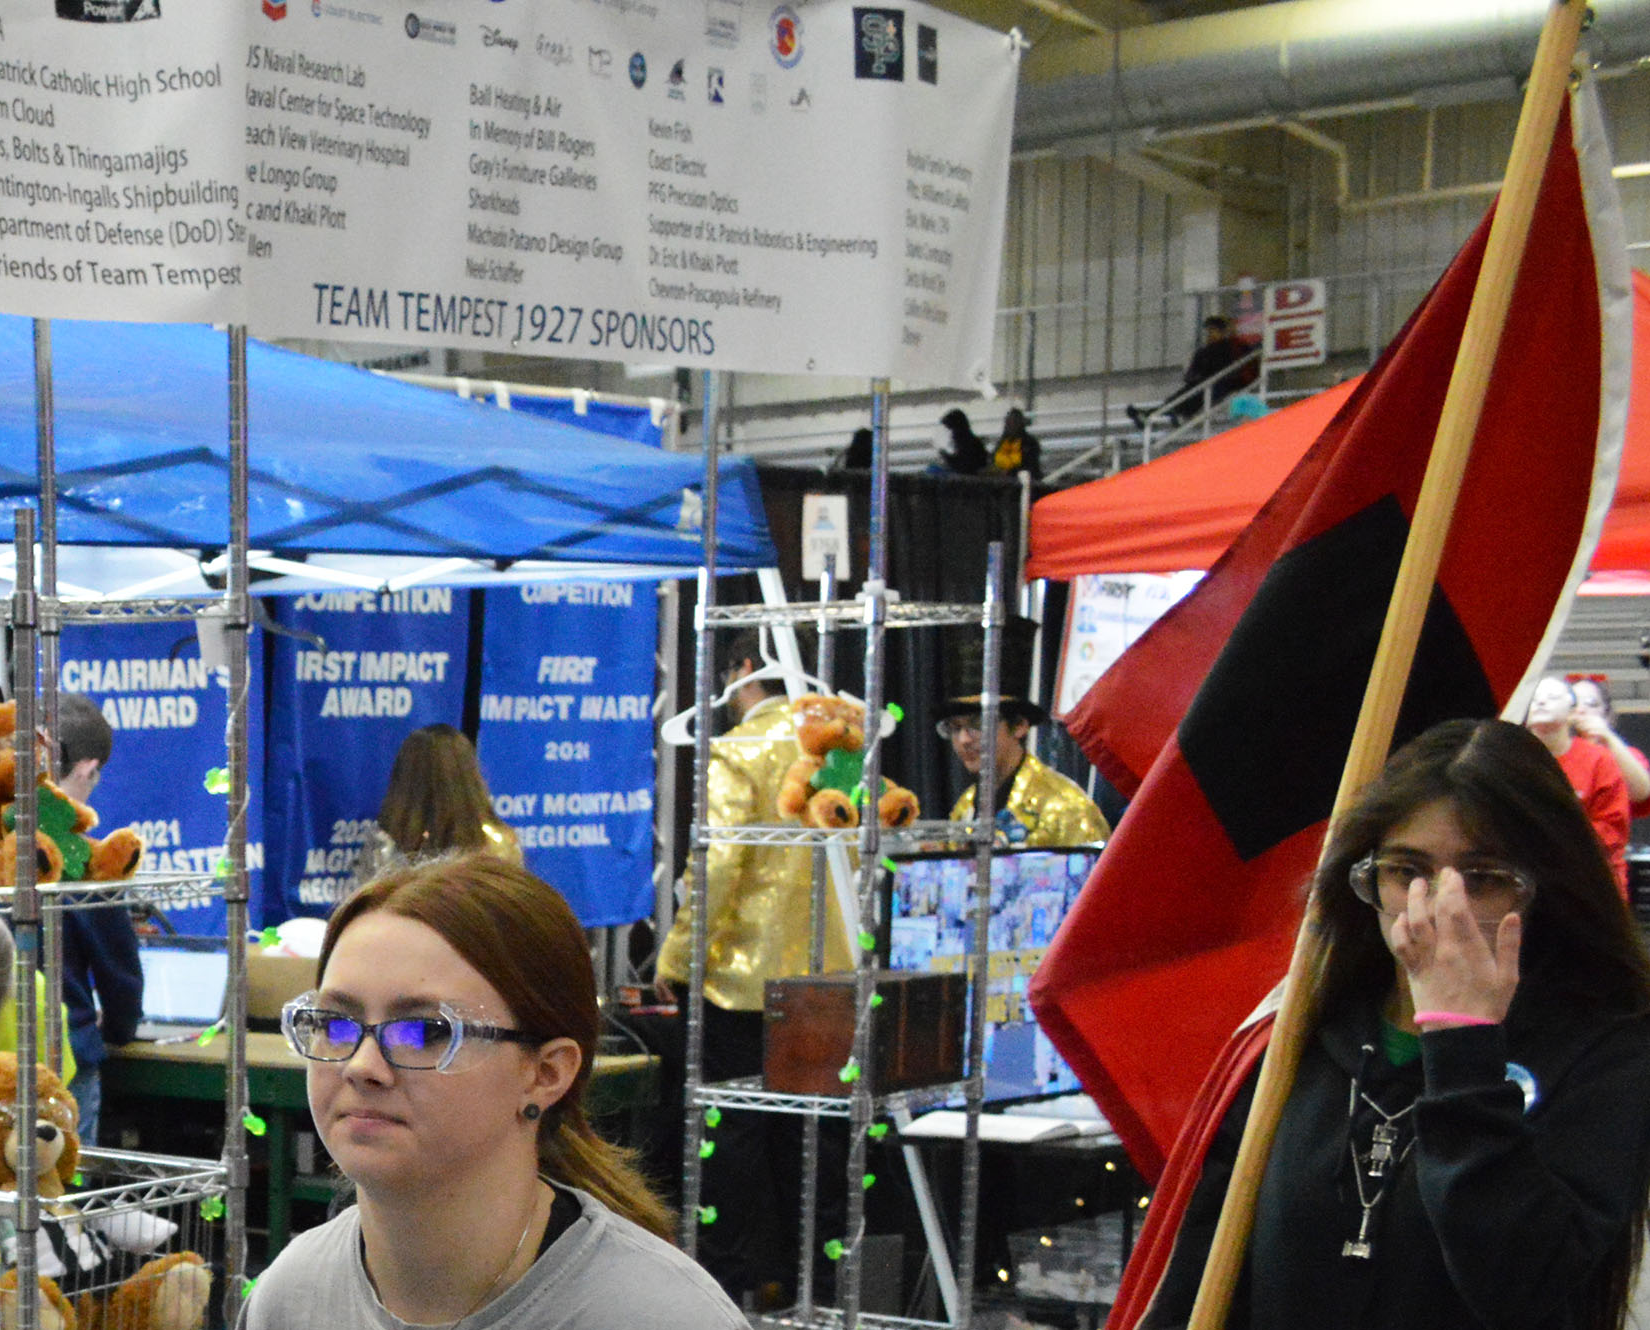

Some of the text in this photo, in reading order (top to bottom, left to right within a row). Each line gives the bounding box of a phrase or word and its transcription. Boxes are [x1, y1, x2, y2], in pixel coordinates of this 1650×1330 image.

[40, 65, 101, 98] Catholic
[105, 73, 151, 103] High
[156, 63, 222, 93] School
[263, 47, 296, 75] Naval
[299, 53, 344, 85] Research
[346, 62, 366, 89] Lab
[12, 98, 55, 128] Cloud
[279, 87, 315, 116] Center
[318, 93, 333, 118] for
[335, 97, 366, 127] Space
[368, 103, 432, 140] Technology
[533, 94, 541, 116] &
[544, 96, 562, 119] Air
[246, 124, 410, 168] each View Veterinary Hospital
[470, 118, 481, 140] In
[524, 127, 536, 148] of
[537, 129, 555, 151] Bill
[558, 131, 596, 161] Rogers
[13, 136, 50, 166] Bolts
[53, 150, 64, 167] &
[67, 144, 189, 178] Thingamajigs
[260, 160, 300, 192] Longo
[303, 166, 338, 196] Group
[502, 158, 546, 185] Furniture
[549, 165, 598, 191] Galleries
[123, 181, 239, 213] Shipbuilding
[256, 201, 282, 223] and
[284, 202, 318, 226] Khaki
[320, 205, 347, 230] Plott
[76, 220, 91, 243] of
[96, 221, 163, 246] Defense
[168, 218, 222, 248] (DoD)
[549, 232, 589, 262] Design
[592, 237, 623, 265] Group
[648, 214, 692, 240] Supporter
[719, 223, 750, 246] Patrick
[753, 227, 793, 251] Robotics
[807, 233, 878, 258] Engineering
[63, 260, 83, 283] of
[87, 261, 148, 286] Team
[152, 263, 242, 289] Tempest
[313, 282, 715, 356] TEAM TEMPEST 1927 SPONSORS
[1275, 323, 1315, 351] E
[296, 652, 449, 682] IRST IMPACT
[102, 696, 198, 729] AWARD
[320, 687, 412, 717] AWARD
[480, 694, 575, 722] IMPACT
